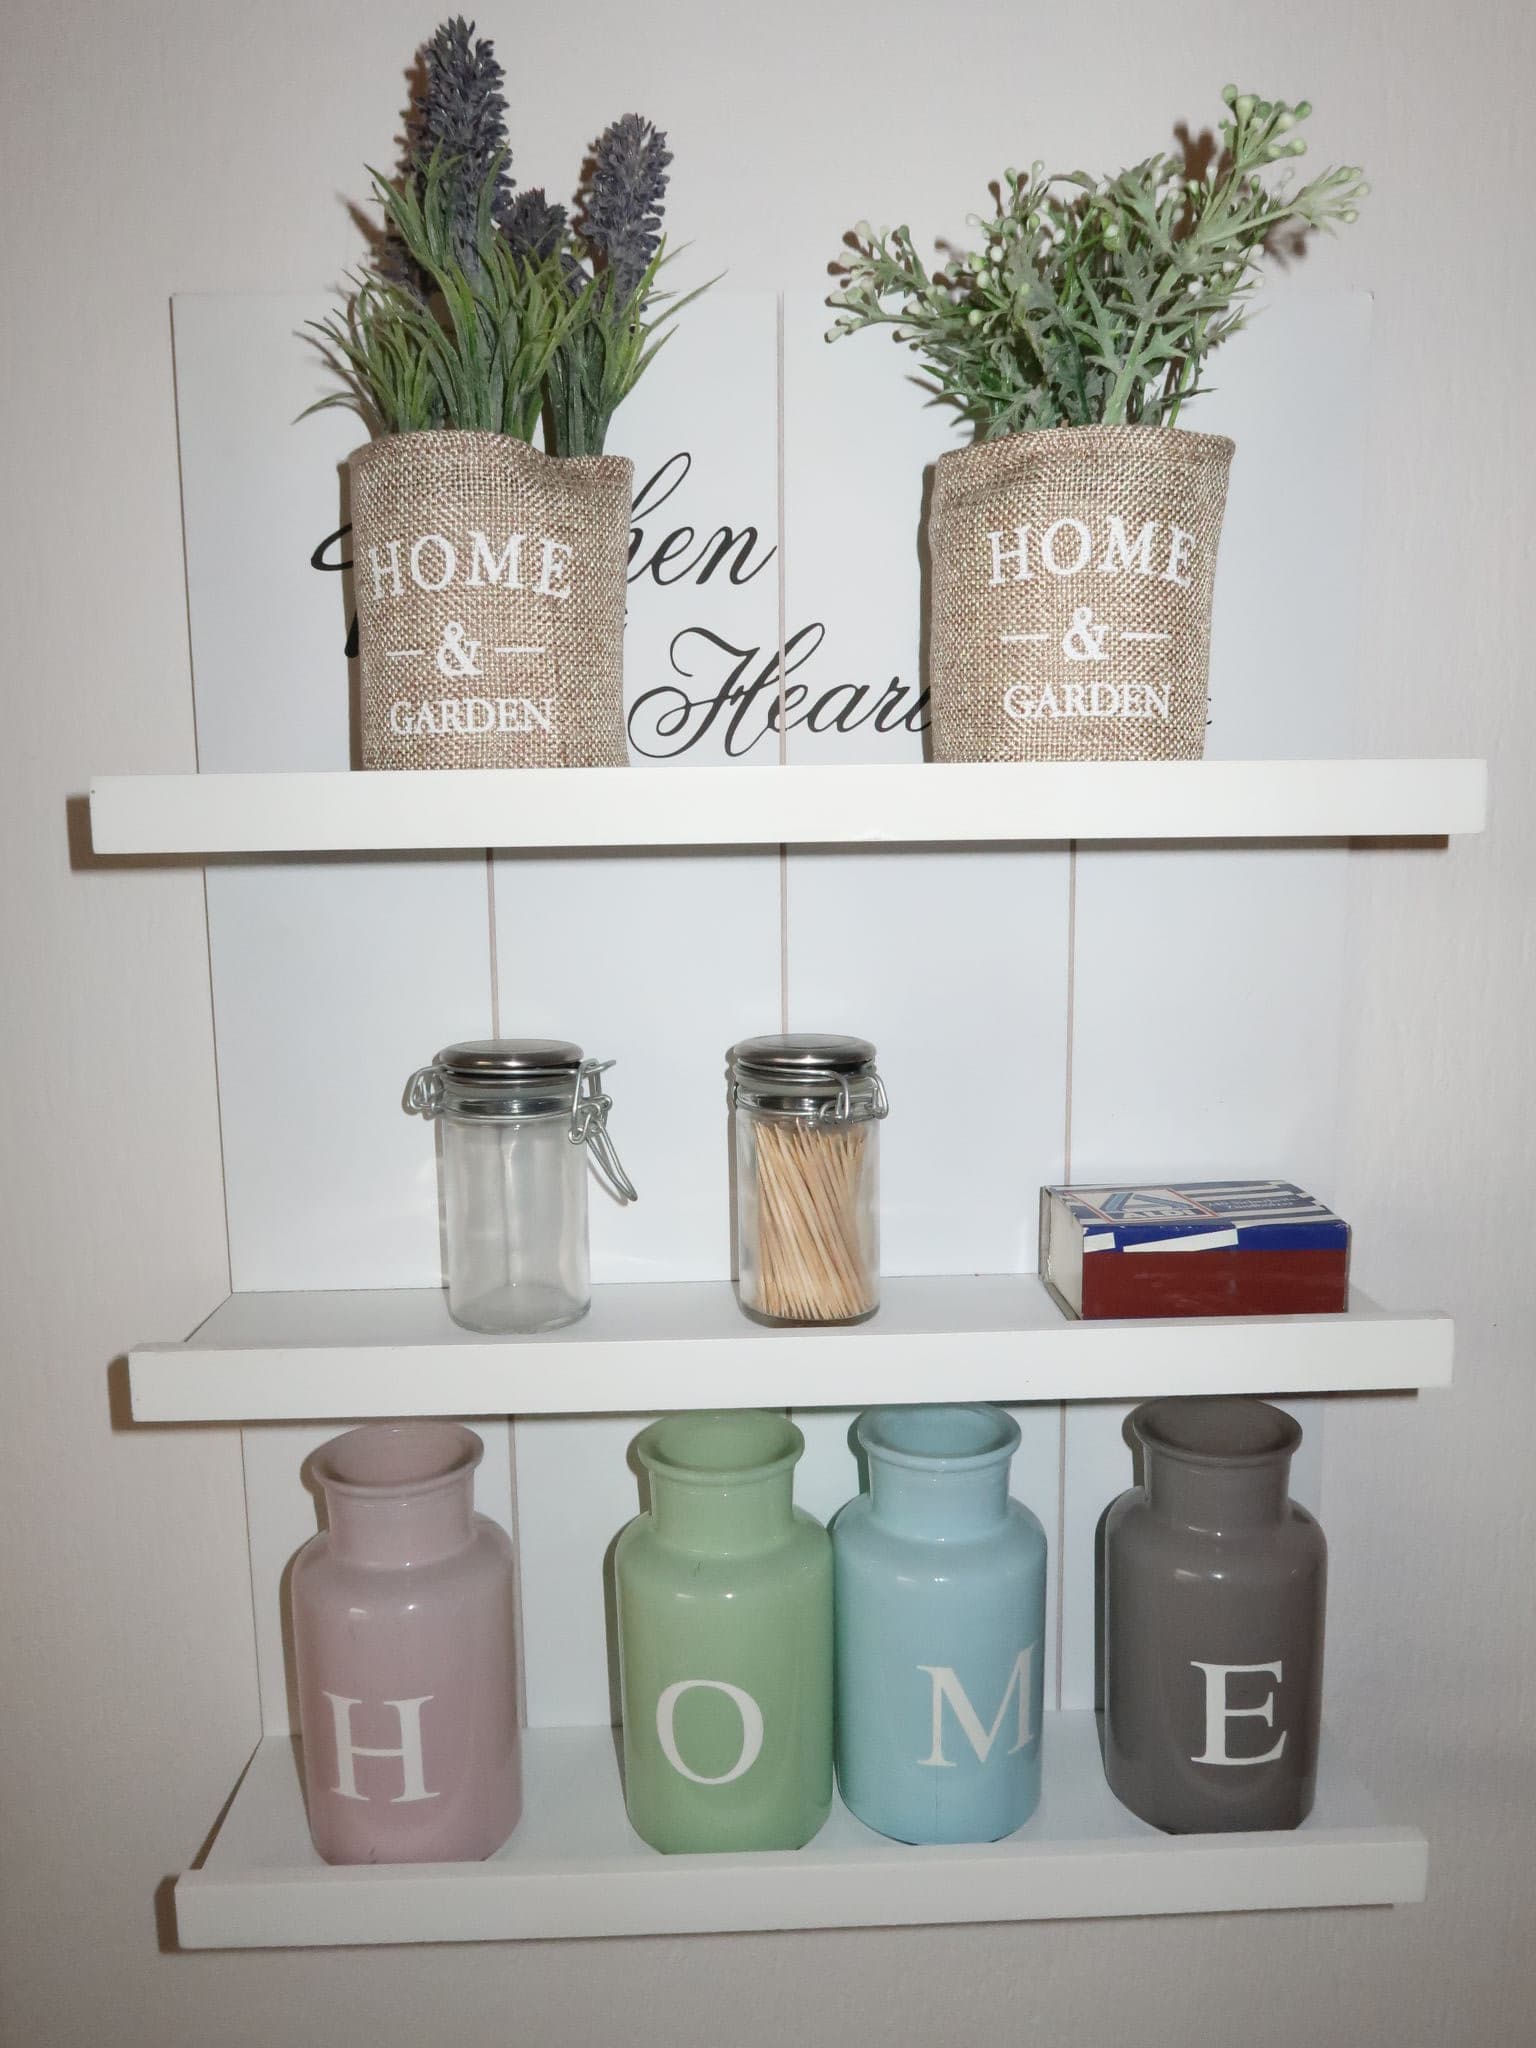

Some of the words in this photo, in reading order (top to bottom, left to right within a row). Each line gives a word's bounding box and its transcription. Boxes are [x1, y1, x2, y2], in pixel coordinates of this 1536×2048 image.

[366, 530, 574, 602] HOME
[986, 516, 1197, 588] HOME
[436, 621, 482, 679] &
[1062, 607, 1109, 661] &
[390, 697, 552, 736] GARDEN
[1003, 681, 1171, 721] GARDEN
[1122, 1209, 1199, 1218] ALDI
[655, 1679, 764, 1785] O
[916, 1643, 1036, 1768] M
[1190, 1660, 1287, 1766] E
[322, 1690, 441, 1803] H
